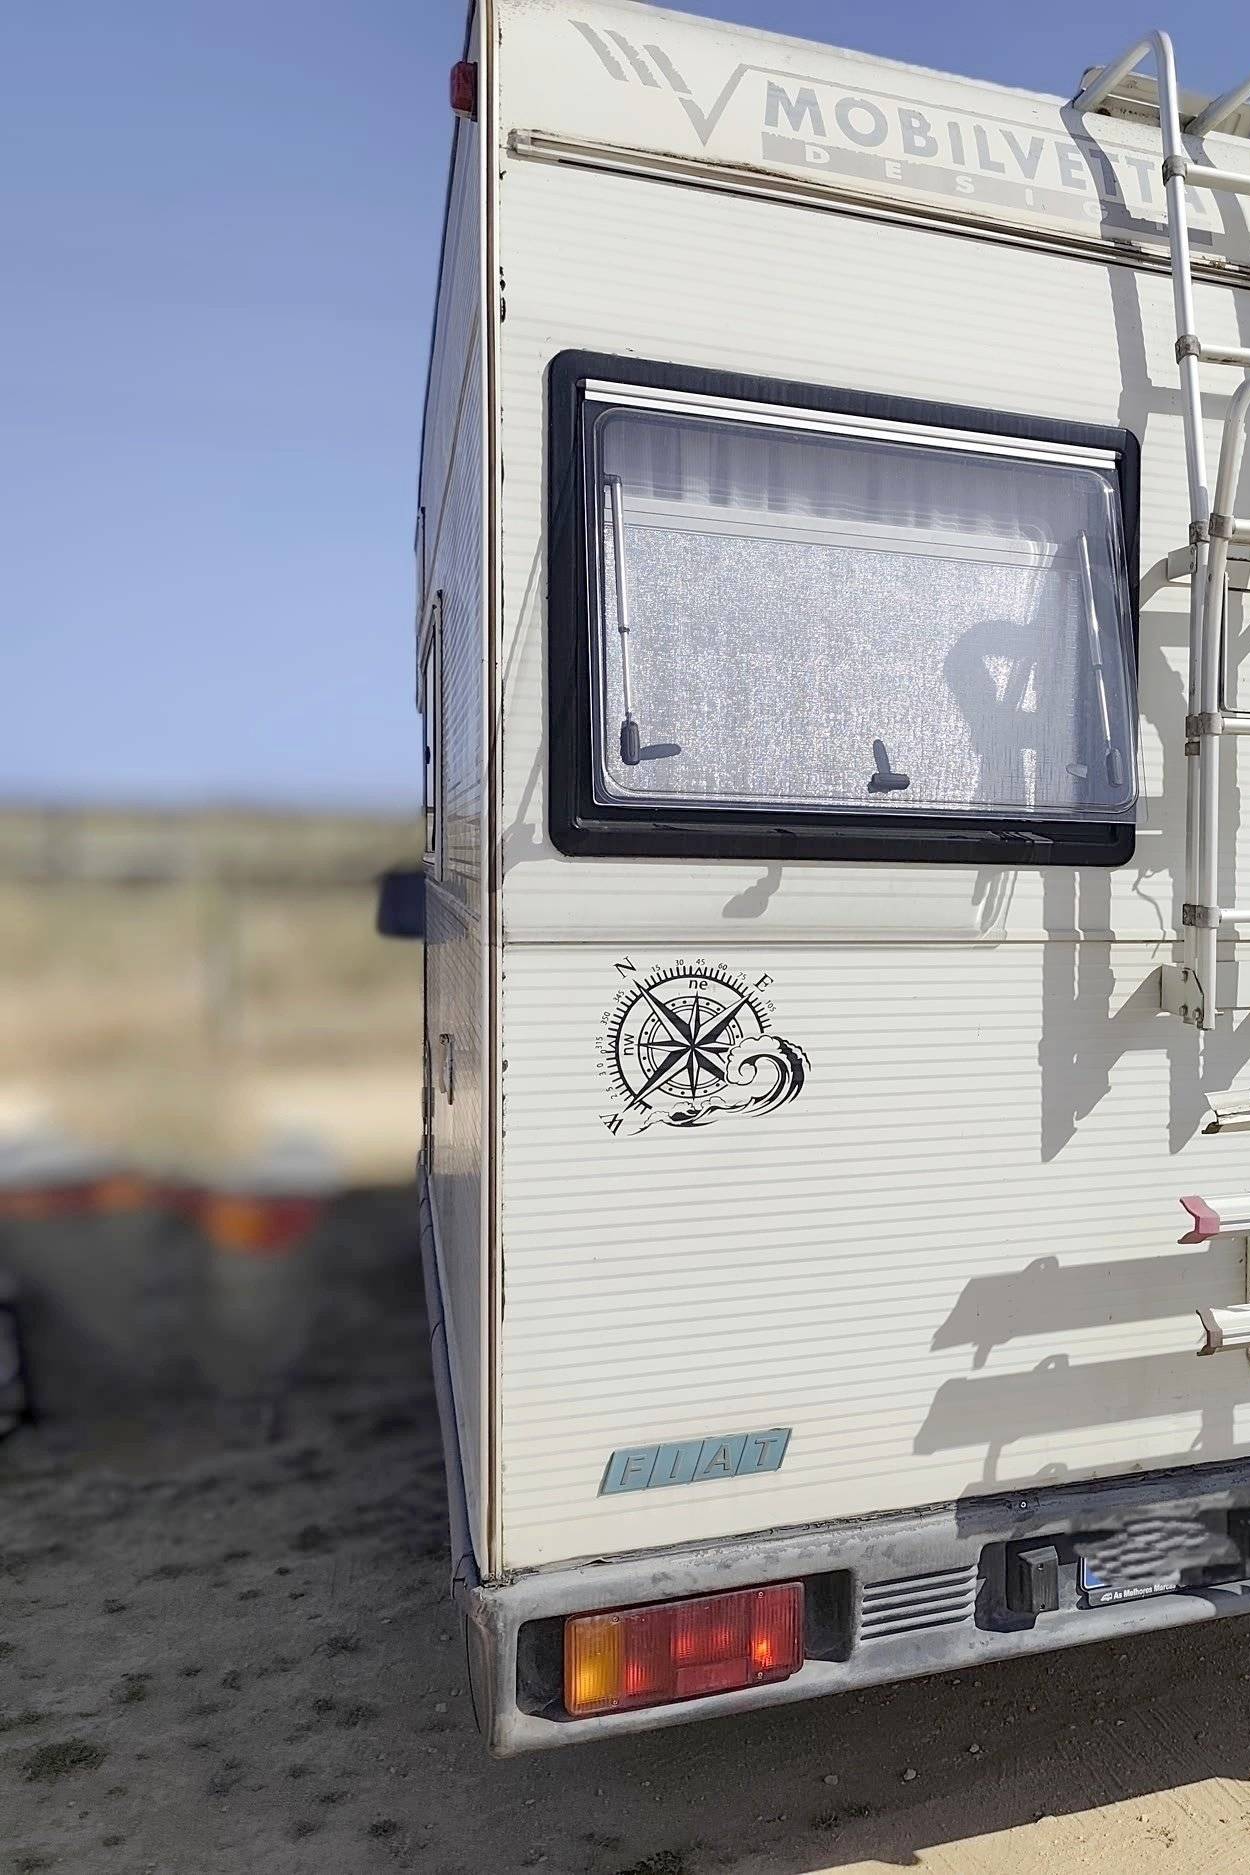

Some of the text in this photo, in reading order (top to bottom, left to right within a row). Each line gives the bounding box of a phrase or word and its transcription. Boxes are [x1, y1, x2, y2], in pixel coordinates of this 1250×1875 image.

[804, 144, 1172, 232] DESIG
[613, 956, 637, 979] N
[651, 964, 661, 973] 15
[695, 958, 706, 966] 45
[717, 962, 728, 971] 60
[737, 971, 748, 981] 75
[753, 972, 774, 992] E
[688, 979, 708, 990] ne
[613, 990, 625, 1003] 345
[765, 999, 777, 1013] 105
[600, 1011, 611, 1026] 350
[595, 1036, 604, 1049] 315
[623, 1033, 635, 1056] nw
[599, 1113, 624, 1136] W
[619, 1438, 779, 1486] FIAT
[1113, 1591, 1123, 1600] As
